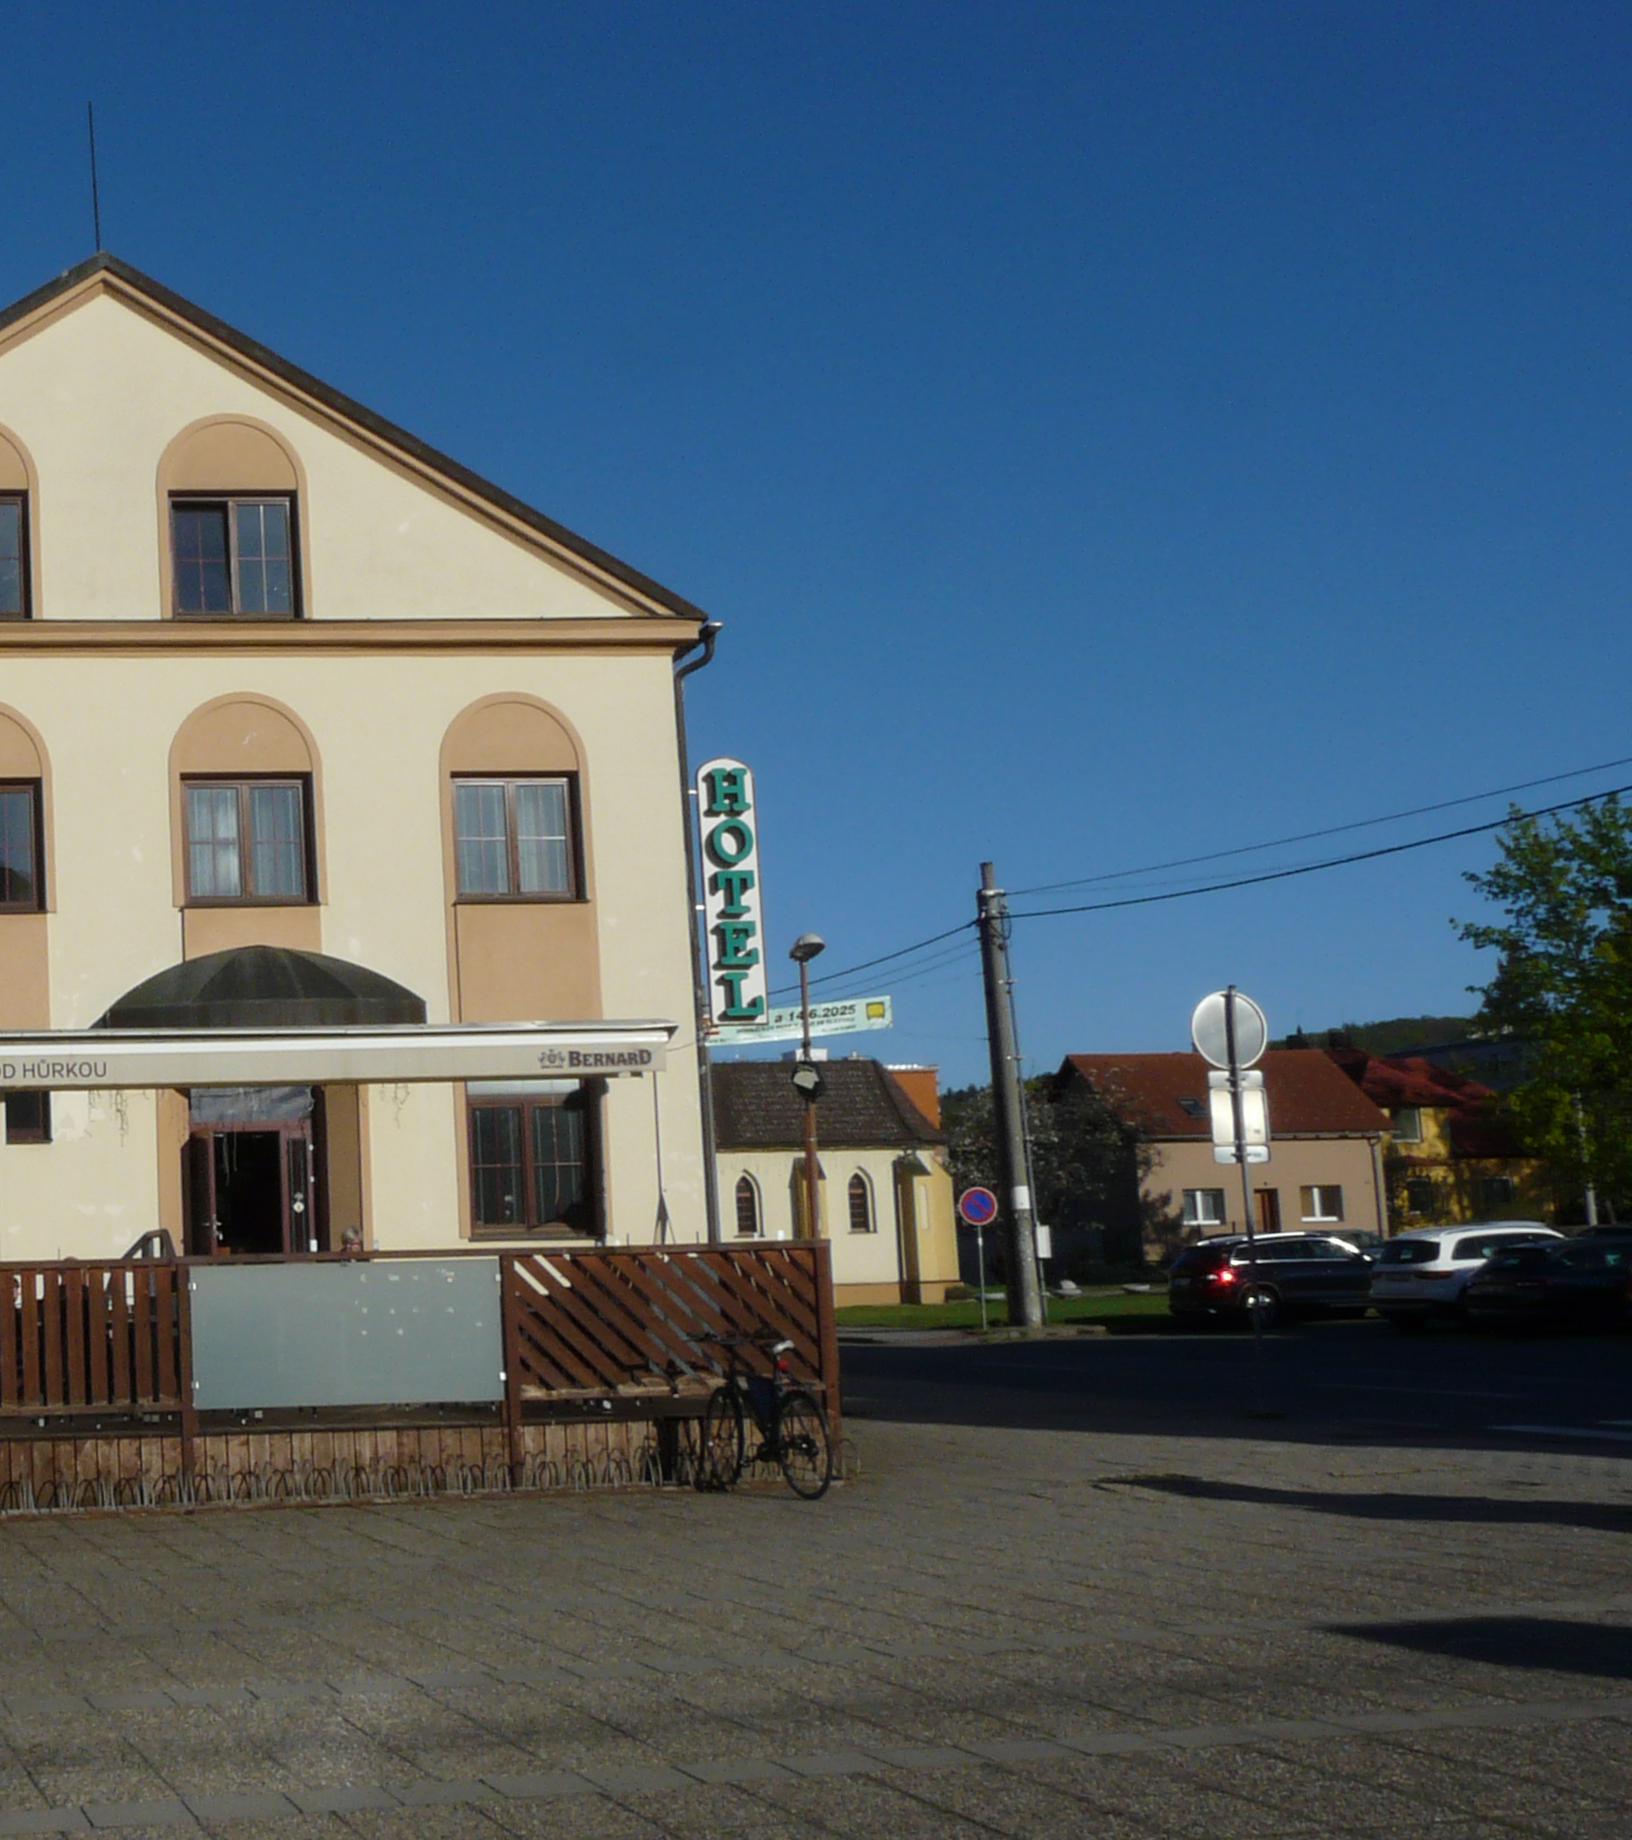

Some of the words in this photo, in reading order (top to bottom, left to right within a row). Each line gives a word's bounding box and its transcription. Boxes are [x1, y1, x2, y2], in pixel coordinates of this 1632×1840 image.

[703, 767, 765, 1020] HOTEL
[22, 1059, 107, 1079] HŮRKOU
[569, 1050, 652, 1068] BERNARD
